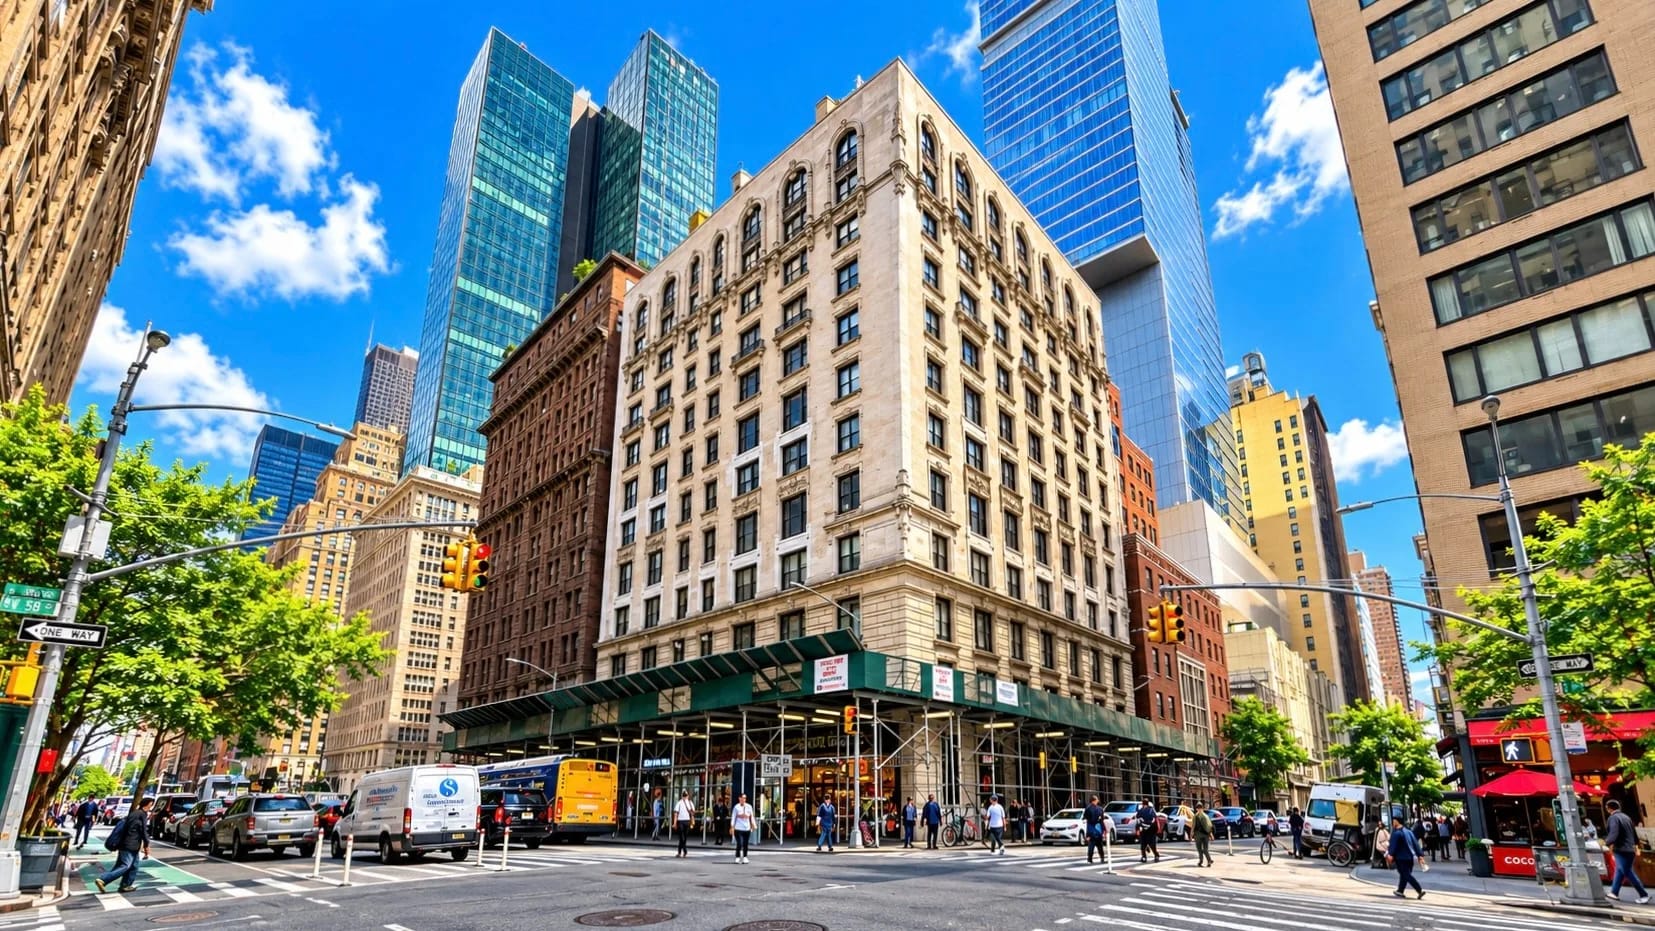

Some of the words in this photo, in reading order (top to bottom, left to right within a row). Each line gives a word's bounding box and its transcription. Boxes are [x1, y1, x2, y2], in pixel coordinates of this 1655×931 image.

[24, 600, 41, 612] 58
[40, 627, 63, 637] ONE
[71, 630, 95, 639] WAY
[1504, 856, 1535, 865] COCO
